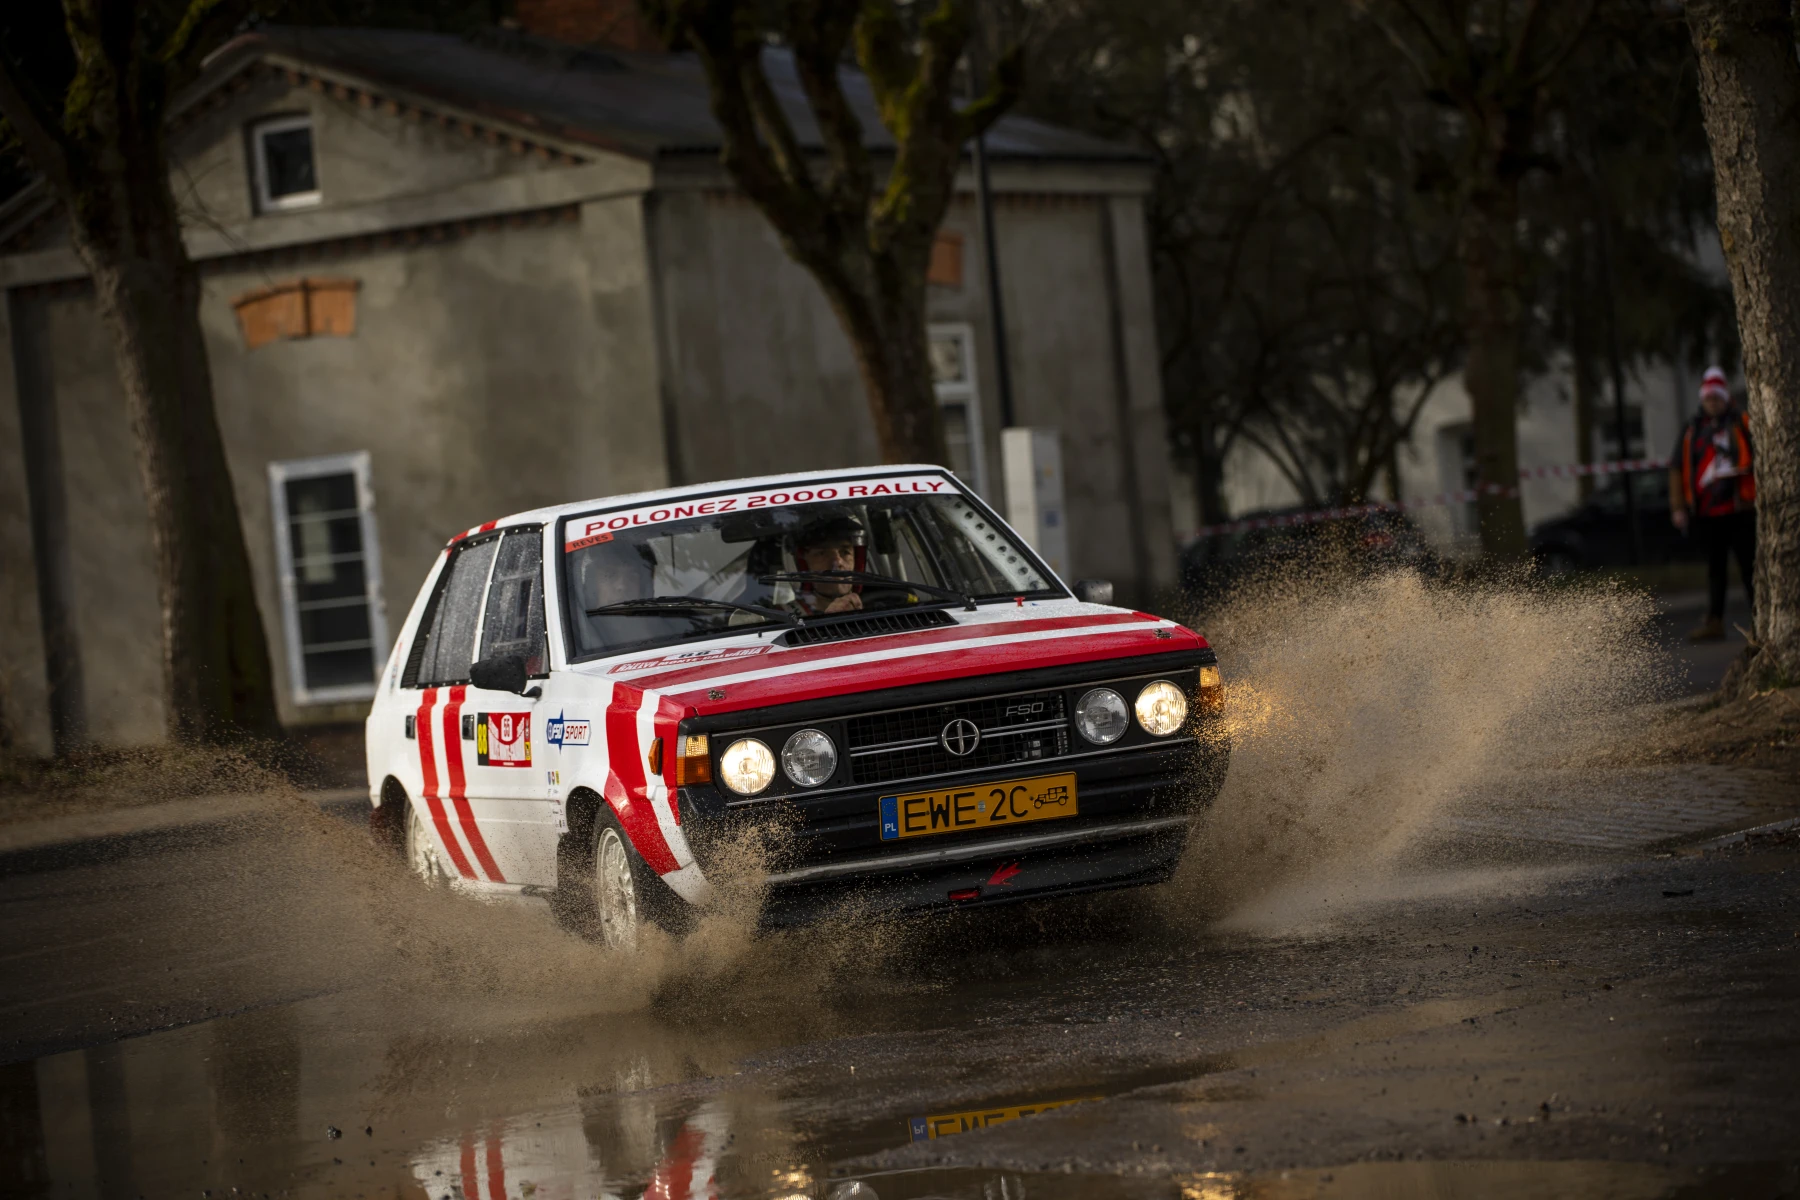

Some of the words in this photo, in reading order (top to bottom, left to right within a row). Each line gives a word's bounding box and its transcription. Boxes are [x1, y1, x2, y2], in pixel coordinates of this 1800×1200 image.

[585, 499, 738, 536] POLONEZ
[747, 488, 838, 509] 2000
[848, 481, 945, 498] RALLY
[572, 534, 608, 548] REVES
[1005, 702, 1044, 717] FSO
[478, 723, 488, 755] 88
[565, 725, 587, 740] SPORT
[903, 791, 976, 833] EWE
[988, 785, 1029, 822] 2C
[884, 822, 897, 833] PL
